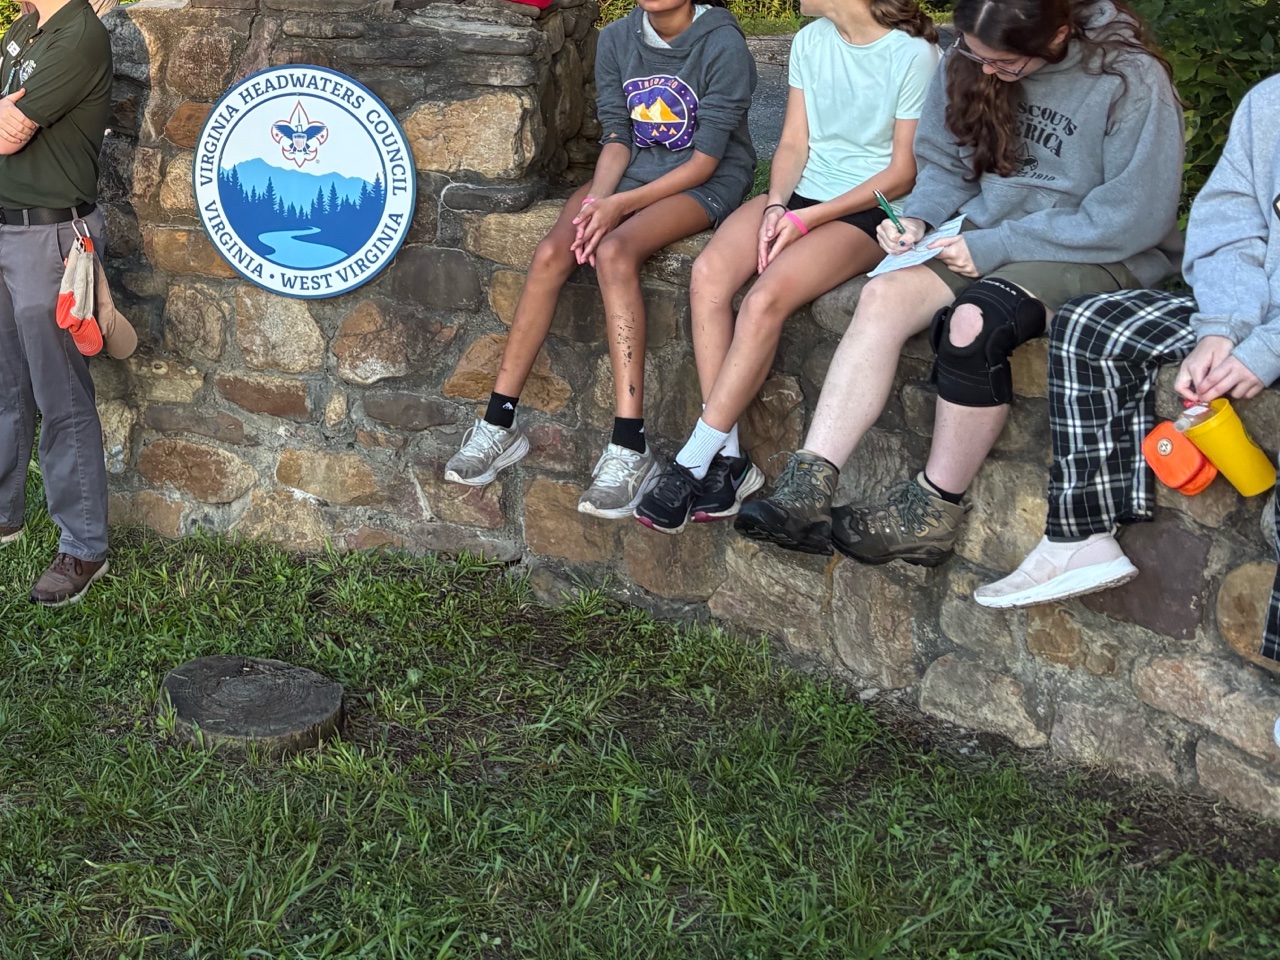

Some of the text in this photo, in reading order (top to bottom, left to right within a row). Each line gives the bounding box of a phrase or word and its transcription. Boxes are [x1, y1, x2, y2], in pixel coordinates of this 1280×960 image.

[638, 78, 665, 90] TROOP
[200, 73, 407, 196] VIRGINIA HEADWATERS COUNCIL
[1017, 101, 1078, 136] SCOUTS
[204, 199, 404, 291] VIRGINIA WEST VIRGINIA
